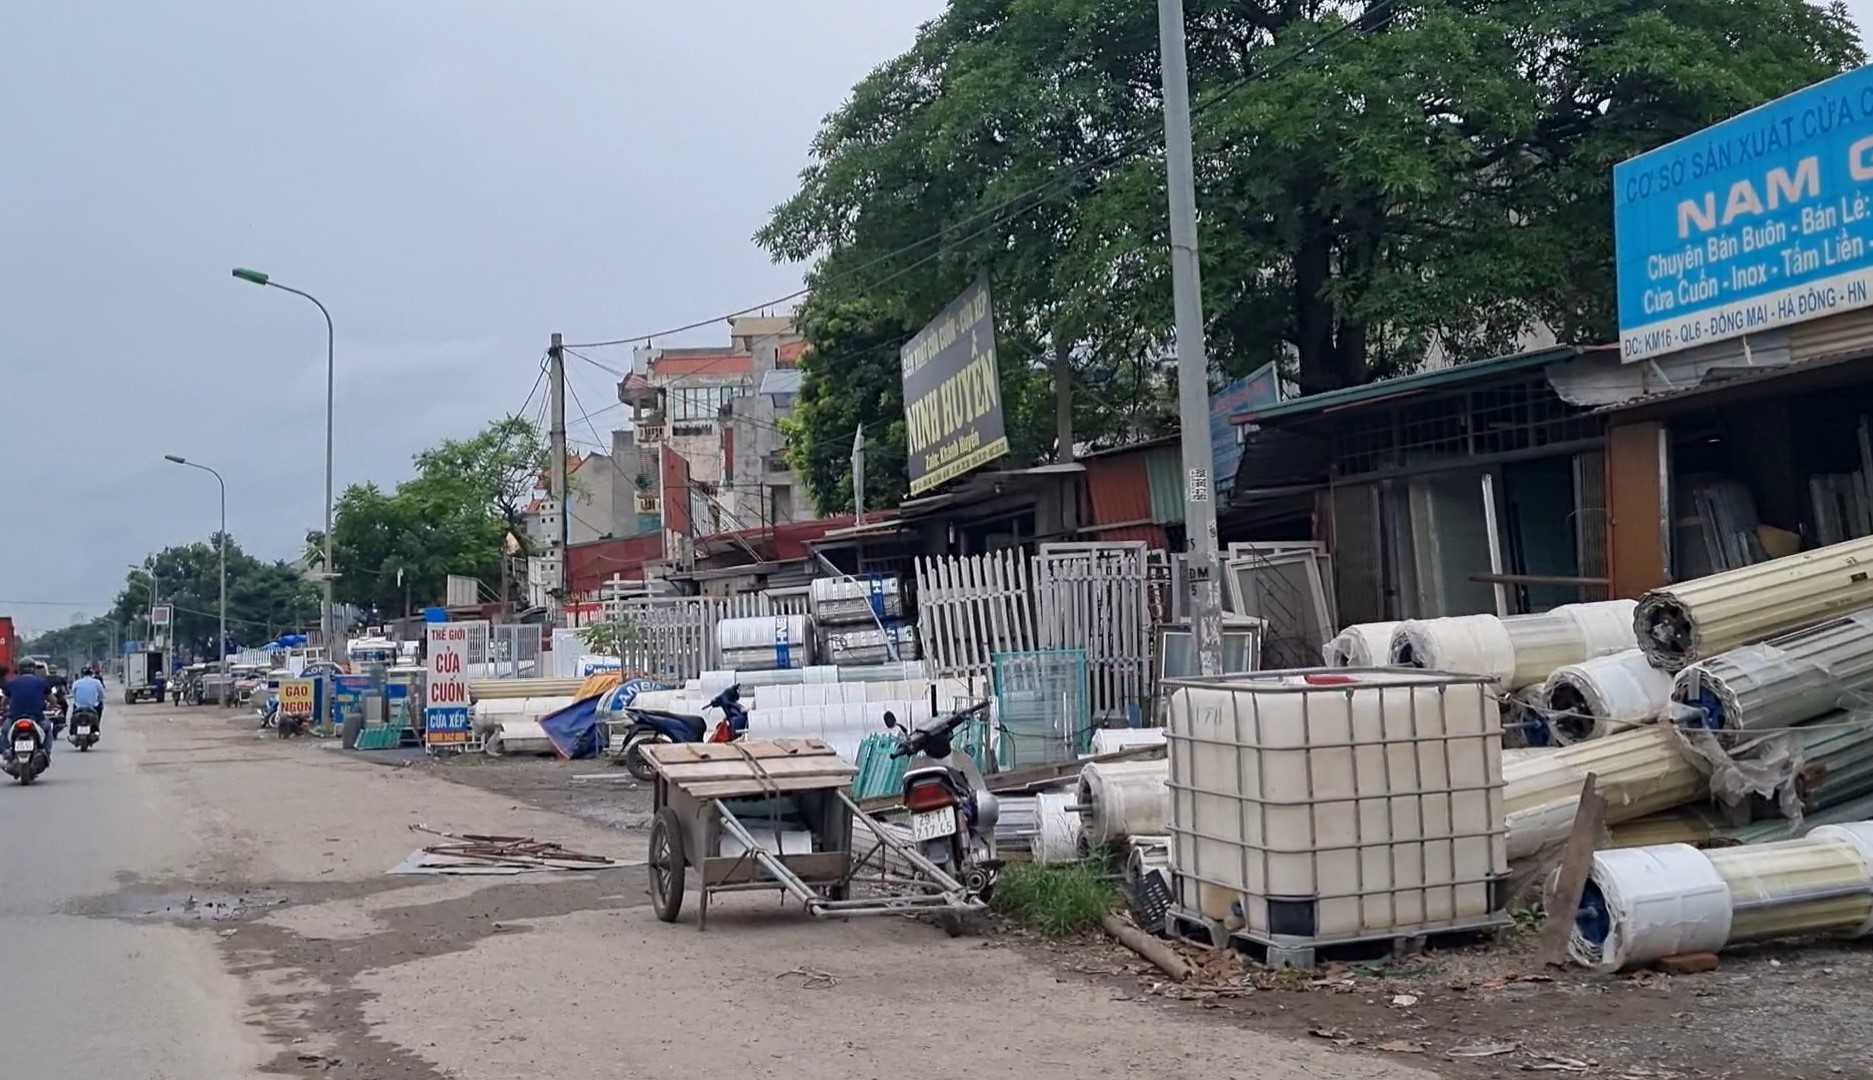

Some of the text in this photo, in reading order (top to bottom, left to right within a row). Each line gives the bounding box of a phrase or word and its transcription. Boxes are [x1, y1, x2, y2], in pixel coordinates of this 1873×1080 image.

[1626, 169, 1654, 203] CƠ
[1660, 156, 1687, 192] SỞ
[1693, 138, 1731, 179] SẢN
[1739, 114, 1794, 163] XUẤT
[1802, 96, 1854, 139] CỬA
[1678, 155, 1820, 238] NAM
[1648, 243, 1703, 280] Chuyên
[1708, 232, 1738, 263] Bán
[1742, 220, 1785, 252] Buôn
[1802, 203, 1836, 235] Bán
[1842, 190, 1871, 224] Lẻ:
[1644, 286, 1673, 314] Cửa
[1678, 268, 1718, 304] Cuốn
[1732, 262, 1767, 291] Inox
[1781, 240, 1819, 277] Tấm
[1824, 228, 1864, 266] Liền
[1644, 328, 1672, 351] KM16
[1680, 322, 1702, 344] QL6
[1747, 304, 1767, 326] MAI
[1778, 292, 1796, 320] HÀ
[1798, 287, 1836, 314] ĐÔNG
[1847, 279, 1867, 303] HN
[906, 388, 941, 456] NINH
[431, 626, 465, 640] THẾ GIỚI
[436, 645, 460, 673] CỬA
[430, 709, 466, 729] CỬA XẾP
[431, 675, 465, 703] CUỐN
